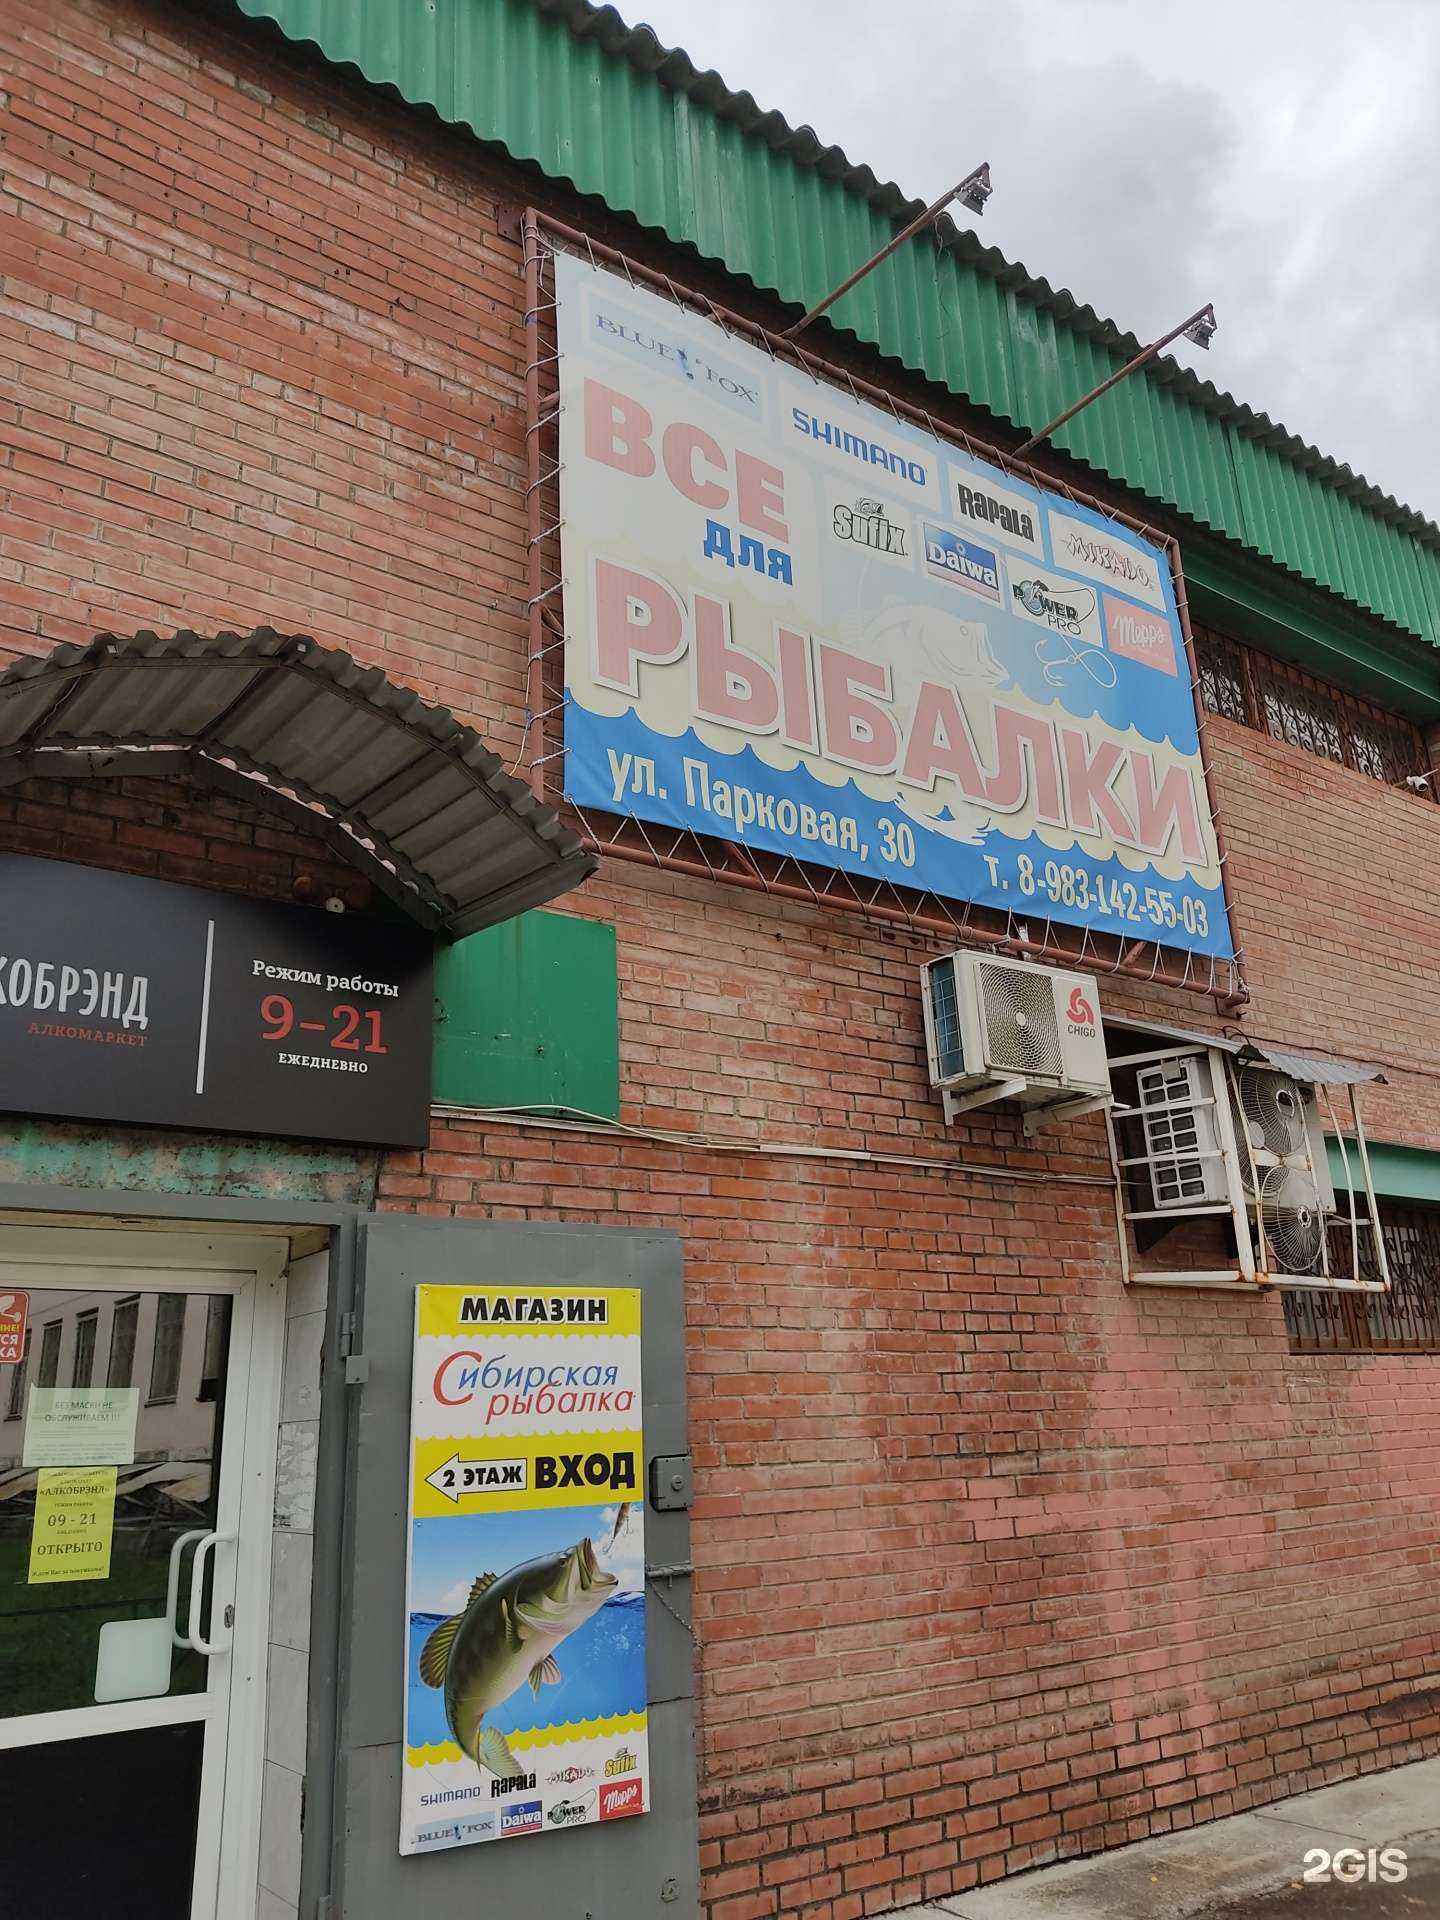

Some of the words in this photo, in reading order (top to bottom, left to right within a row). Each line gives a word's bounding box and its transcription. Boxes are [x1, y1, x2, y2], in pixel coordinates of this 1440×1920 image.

[594, 314, 674, 361] BLUE
[706, 366, 758, 403] FOX
[584, 377, 790, 544] ВСЕ
[792, 407, 927, 487] SHIMANO
[833, 503, 905, 556] Sufix
[927, 541, 998, 588] Daiwa
[1048, 614, 1081, 635] PRO
[1112, 616, 1167, 648] Mepps
[593, 555, 1207, 866] РЫБАЛКИ
[606, 748, 668, 802] ул.
[683, 756, 869, 862] Парковая,
[877, 817, 917, 868] 30
[1016, 853, 1209, 938] 8-983-142-55-03
[252, 959, 322, 986] Режим
[326, 975, 399, 998] работы
[27, 1021, 149, 1047] АЛКОМАРКЕТ
[1068, 1024, 1096, 1038] CHIGO
[278, 1052, 368, 1074] ЕЖЕДНЕВНО
[460, 1296, 607, 1323] МАГАЗИН
[432, 1350, 619, 1406] Сибирская
[485, 1380, 635, 1425] рыбалка
[443, 1469, 456, 1487] 2
[463, 1466, 523, 1487] ЭТАЖ
[535, 1452, 636, 1490] ВХОД
[48, 1513, 66, 1527] 09
[80, 1513, 97, 1525] 21
[37, 1541, 104, 1555] ОТКРЫТО
[420, 1786, 481, 1807] SHIMANO
[416, 1829, 454, 1843] BLUE
[466, 1820, 494, 1834] FOX
[502, 1810, 542, 1828] Daiwa
